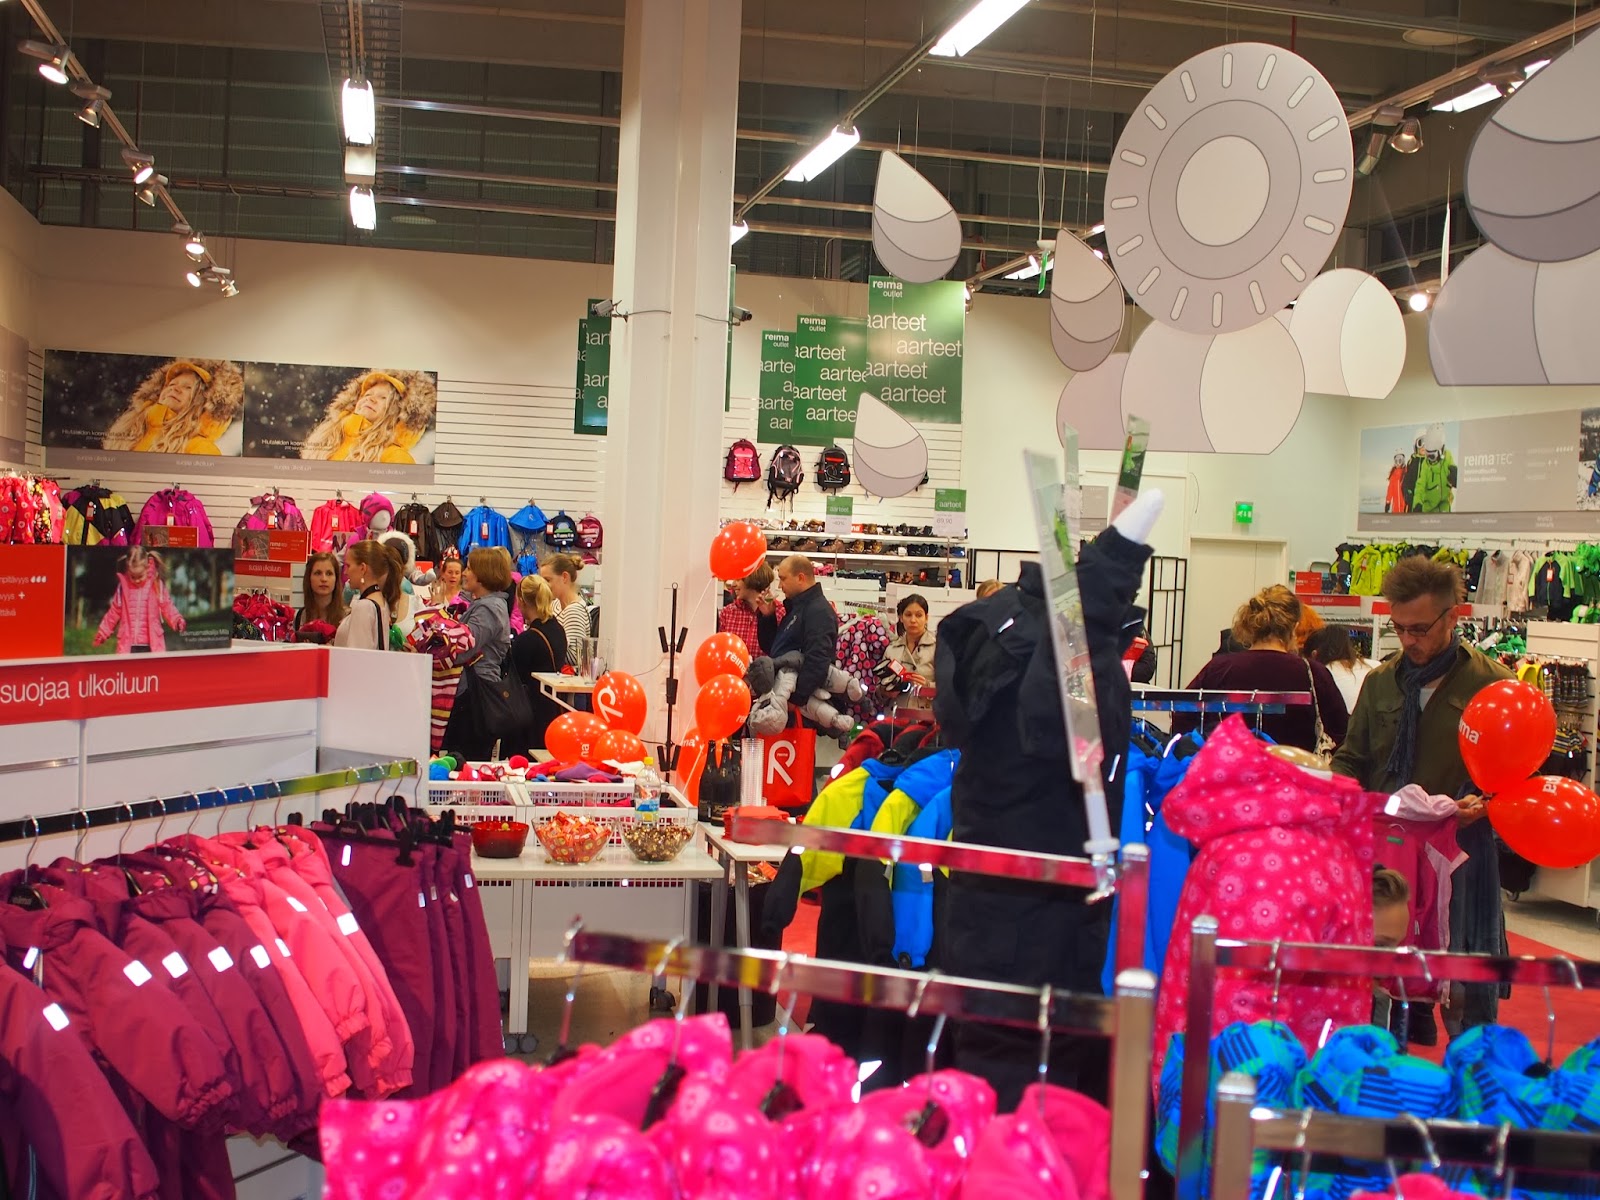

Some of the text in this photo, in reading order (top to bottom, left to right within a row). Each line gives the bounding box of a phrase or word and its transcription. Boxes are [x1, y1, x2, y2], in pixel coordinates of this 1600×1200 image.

[872, 280, 903, 289] reima
[883, 290, 903, 298] outlet
[800, 317, 826, 325] reima
[896, 338, 962, 358] aarteet
[880, 385, 947, 404] aarteet
[0, 672, 159, 707] suojaa ulkoiluun
